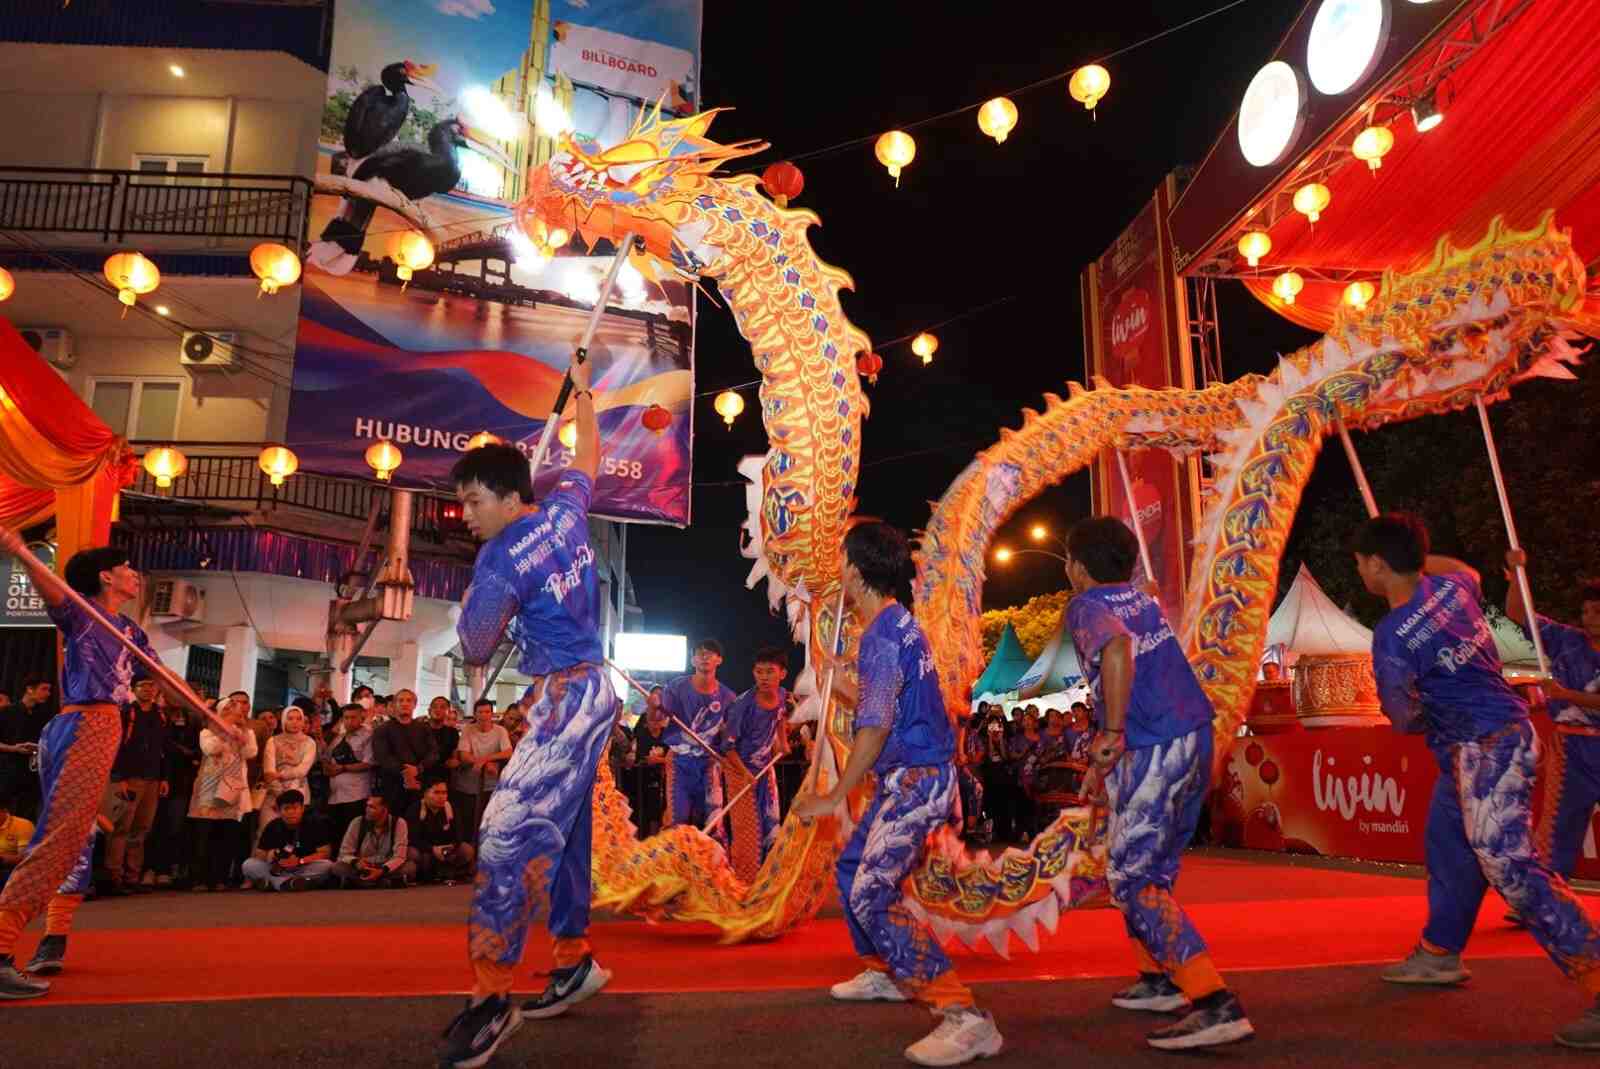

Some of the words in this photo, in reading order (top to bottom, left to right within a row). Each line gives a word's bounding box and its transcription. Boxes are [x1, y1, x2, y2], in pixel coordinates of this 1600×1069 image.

[581, 49, 657, 78] BILLBOARD
[601, 455, 643, 480] 558
[1359, 819, 1370, 835] by
[1371, 820, 1409, 834] mandiri
